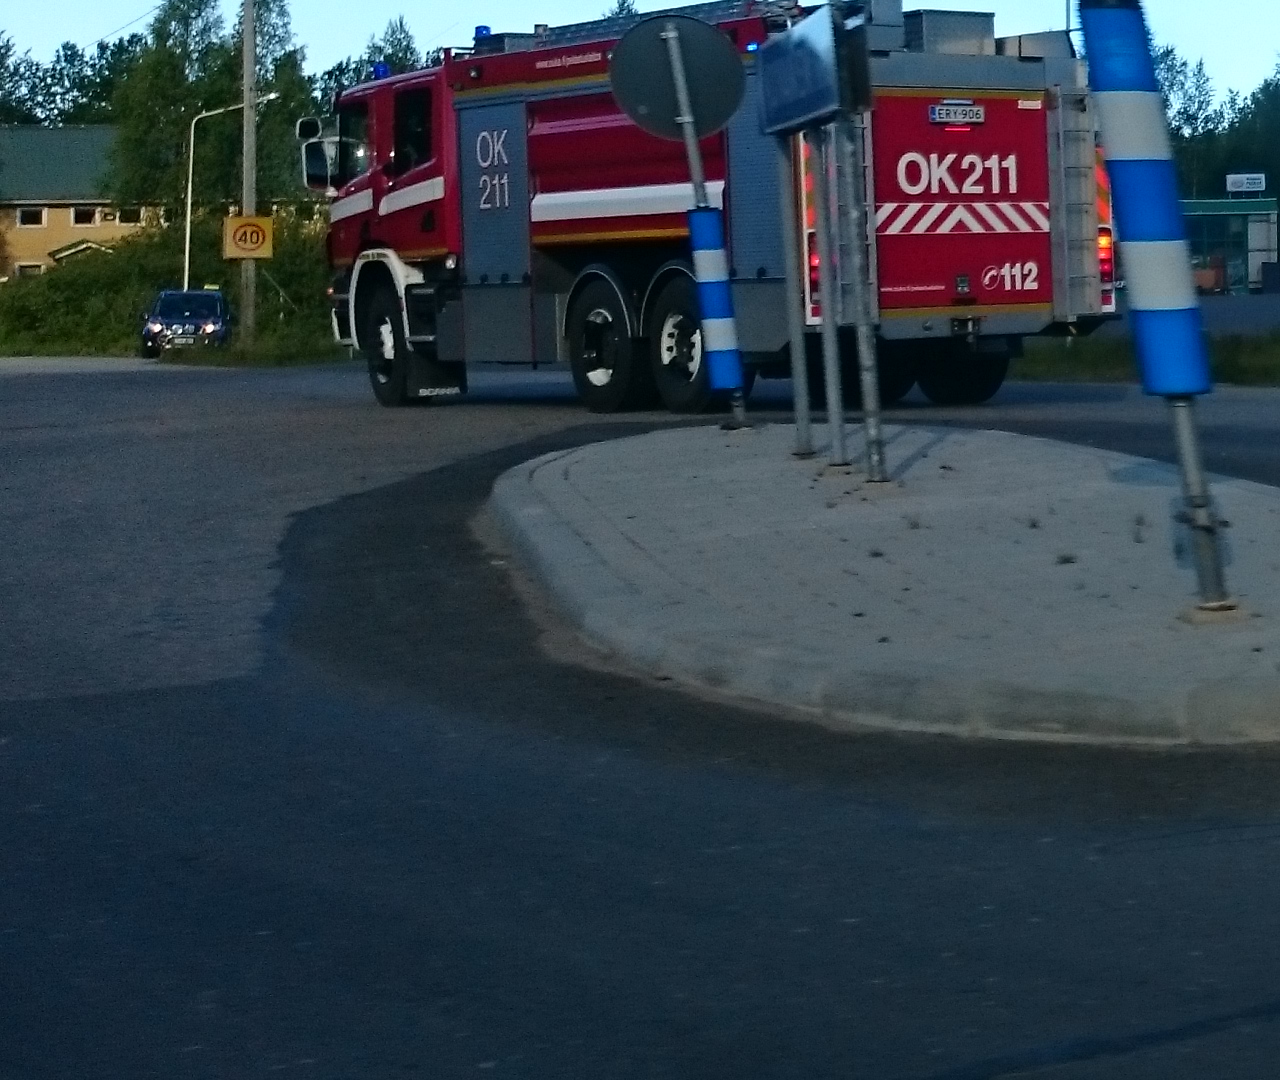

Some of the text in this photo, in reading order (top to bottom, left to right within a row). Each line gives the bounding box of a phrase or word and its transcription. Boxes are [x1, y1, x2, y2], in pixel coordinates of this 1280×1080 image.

[938, 108, 982, 120] ERY-906
[476, 129, 508, 168] OK
[479, 172, 509, 210] 211
[237, 230, 260, 245] 40
[1000, 261, 1039, 291] 112
